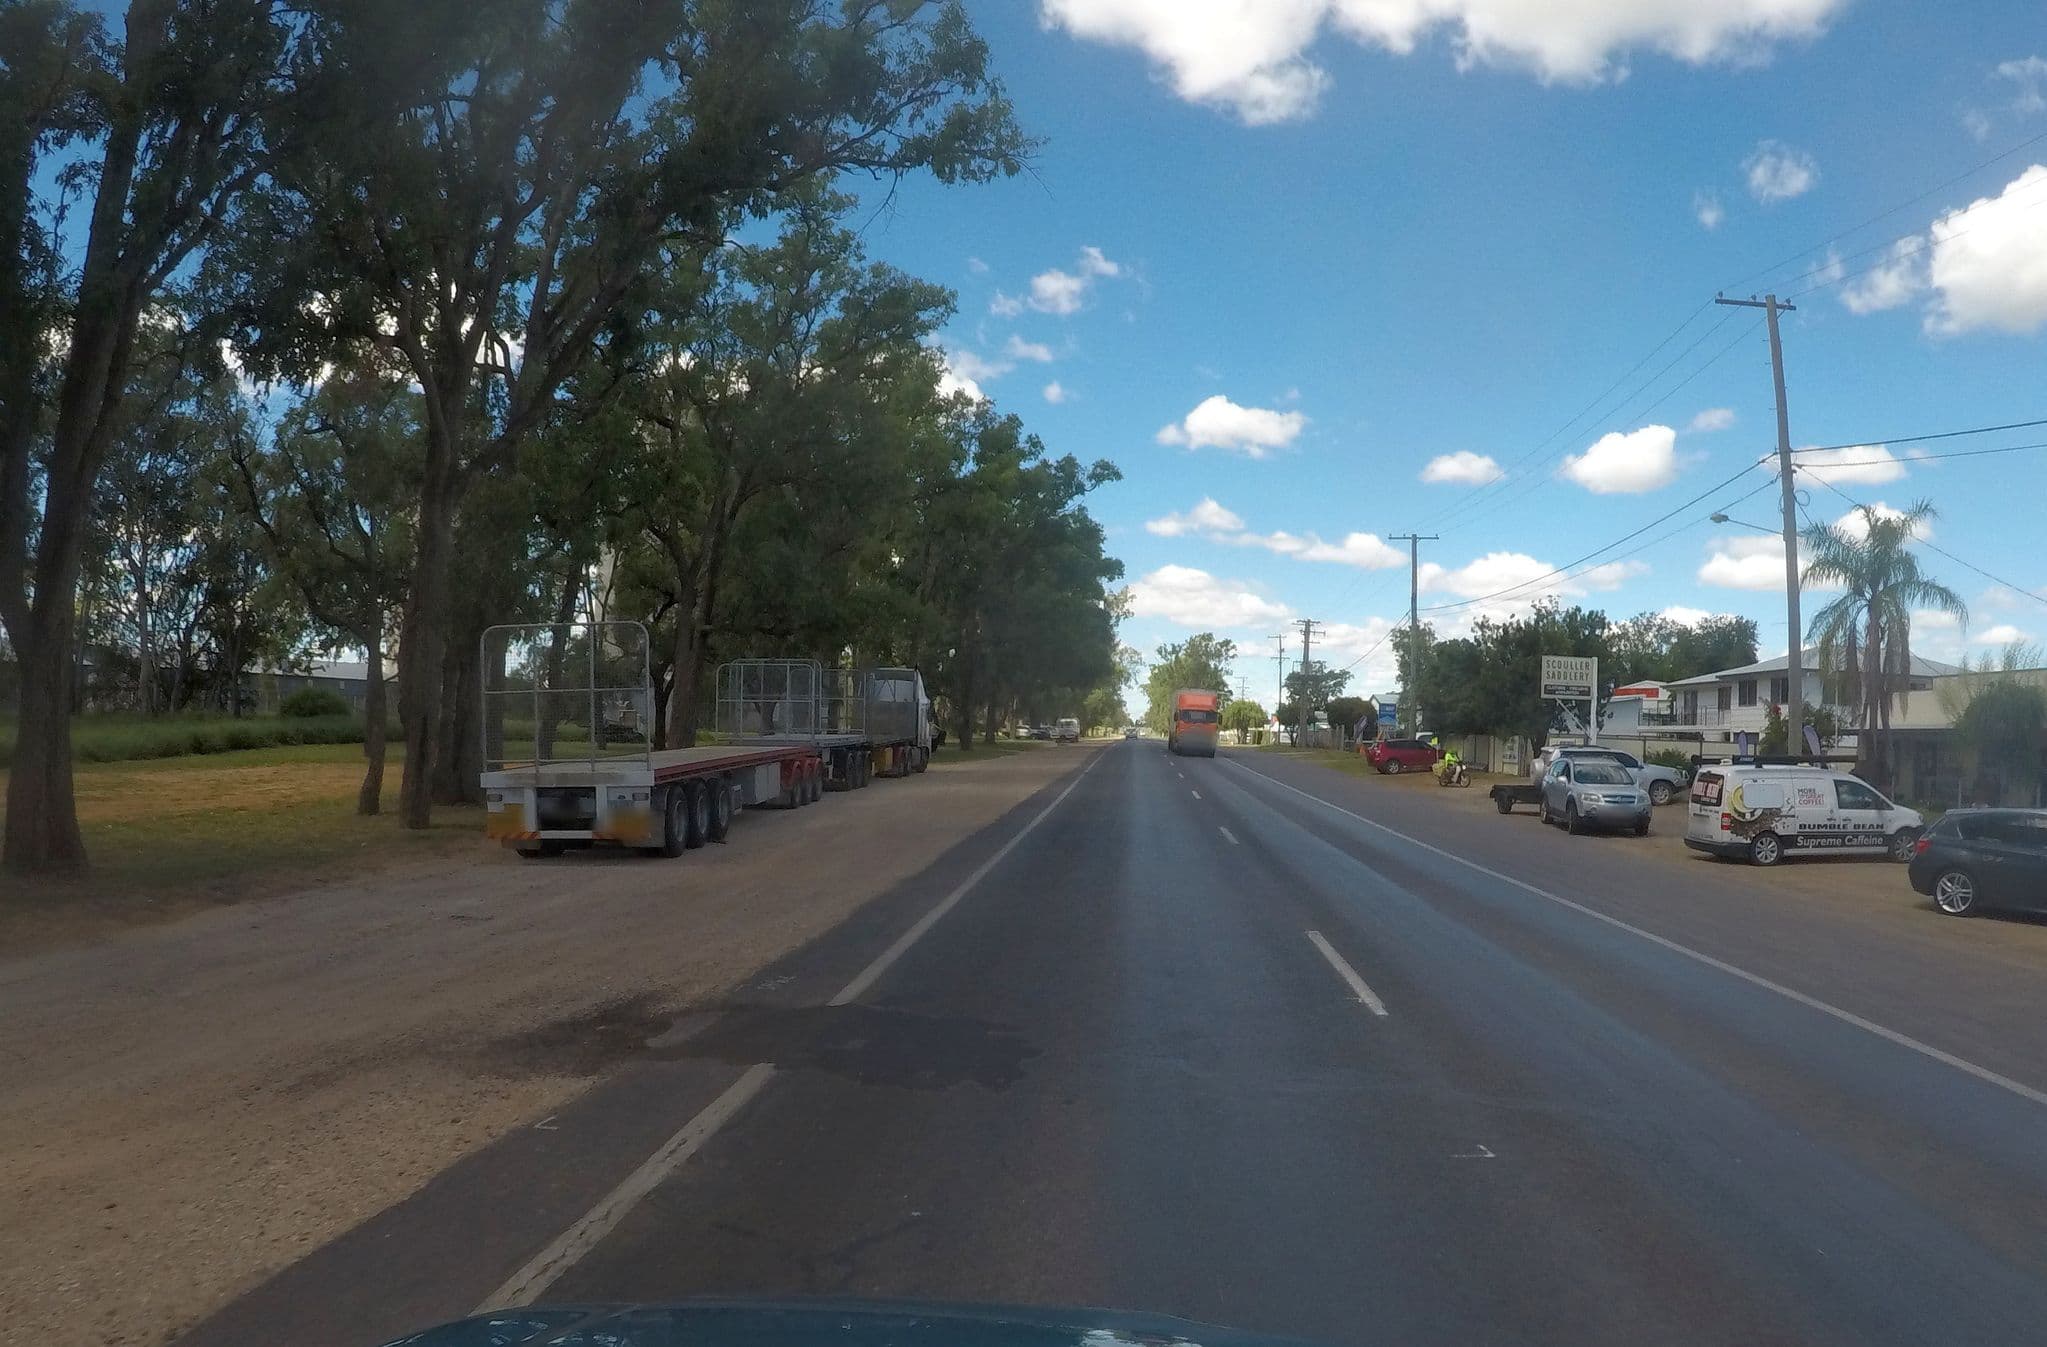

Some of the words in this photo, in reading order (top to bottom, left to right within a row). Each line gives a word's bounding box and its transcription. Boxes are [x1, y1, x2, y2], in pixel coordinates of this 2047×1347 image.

[1545, 659, 1590, 670] SCOULLER
[1545, 670, 1590, 681] SADDLERY
[1797, 787, 1816, 795] MORE
[1798, 823, 1848, 831] BUMBLE
[1853, 823, 1885, 831] BEAN
[1796, 835, 1842, 849] Supreme
[1845, 834, 1884, 847] Caffeine
